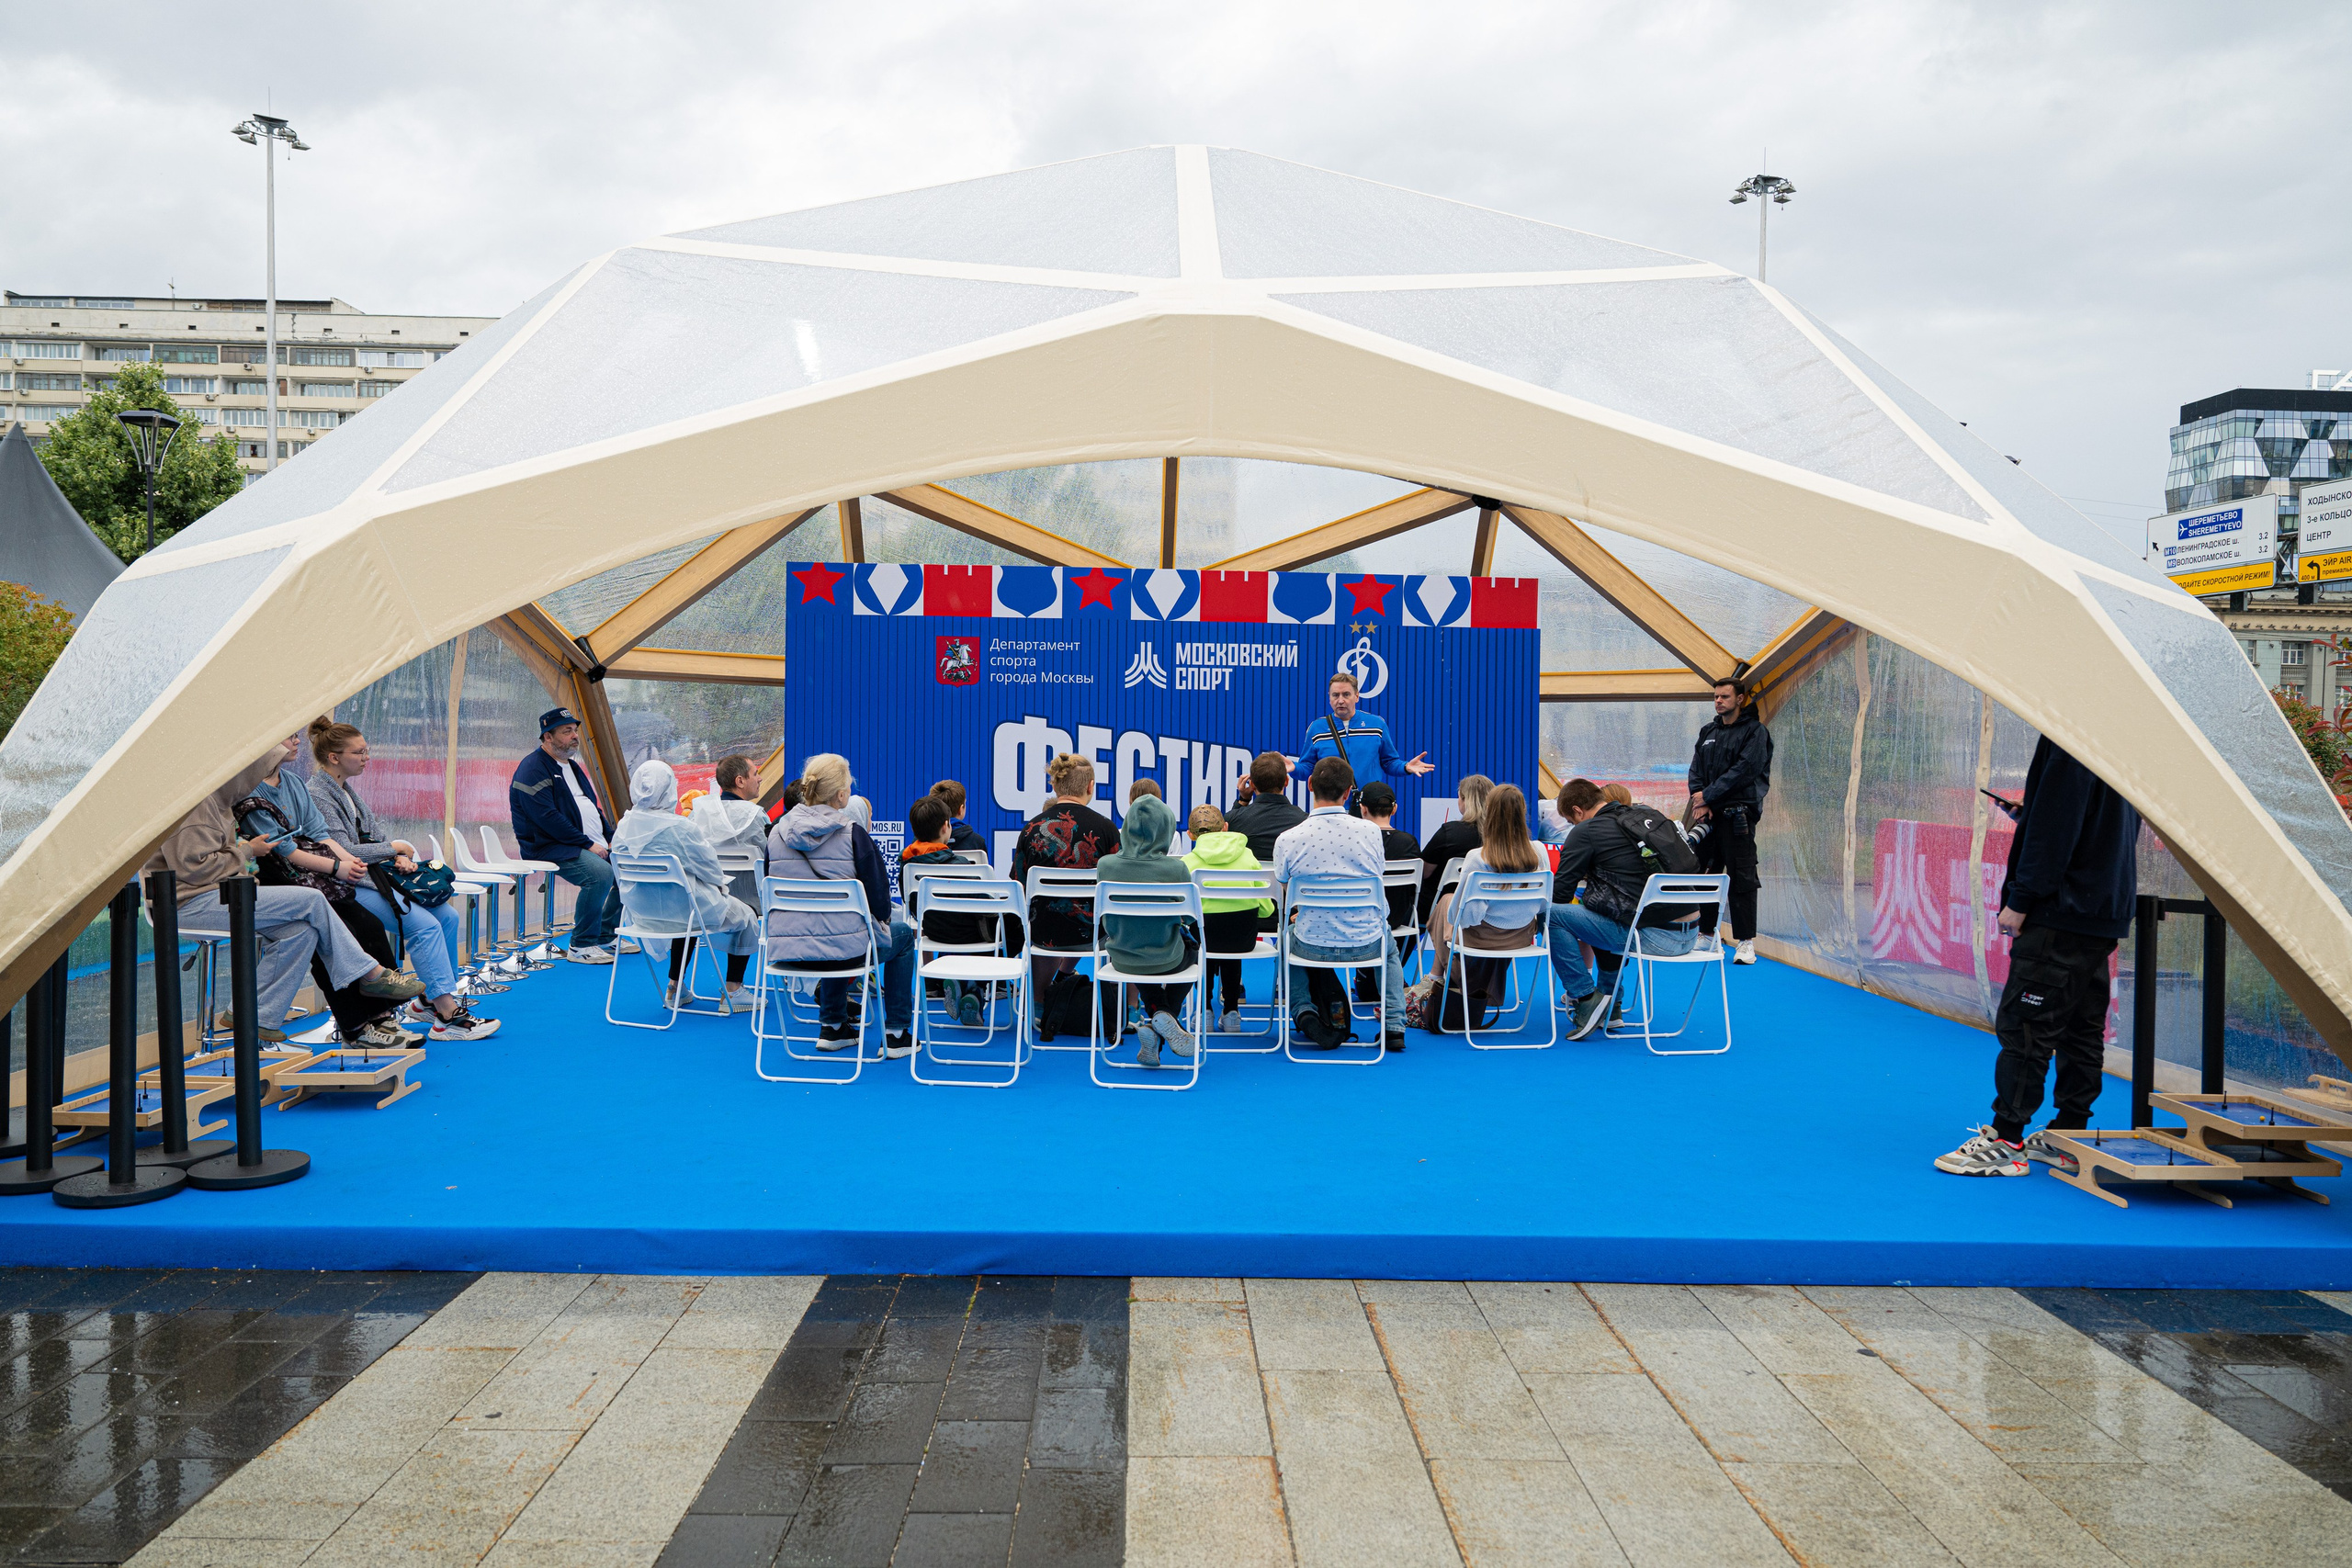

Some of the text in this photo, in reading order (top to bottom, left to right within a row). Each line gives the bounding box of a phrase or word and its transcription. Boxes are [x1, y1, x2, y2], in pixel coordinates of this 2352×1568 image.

[2188, 511, 2238, 527] ШЕРЕМЕТЬЕВО
[2307, 509, 2352, 524] 3-е КОЛЬЦО
[2188, 520, 2242, 537] SHEREMET'YEVO
[2306, 530, 2332, 543] ЦЕНТР
[2177, 538, 2231, 554] ЛЕНИНГРАДСКОЕ
[2258, 532, 2268, 540] 3.2
[2177, 550, 2233, 567] ВОЛОКОЛАМСКОЕ
[2258, 545, 2268, 554] 3.2
[2323, 557, 2338, 567] ЭЙР
[2202, 572, 2244, 587] СКОРОСТНОЙ
[2244, 570, 2270, 581] РЕЖИМ!
[989, 637, 1080, 653] Департамент
[1175, 640, 1298, 668] МОСКОВСКИЙ
[989, 656, 1036, 670] спорта
[989, 671, 1094, 685] города Москвы
[1175, 668, 1233, 691] СПОРТ
[994, 716, 1315, 822] ФЕСТИВ
